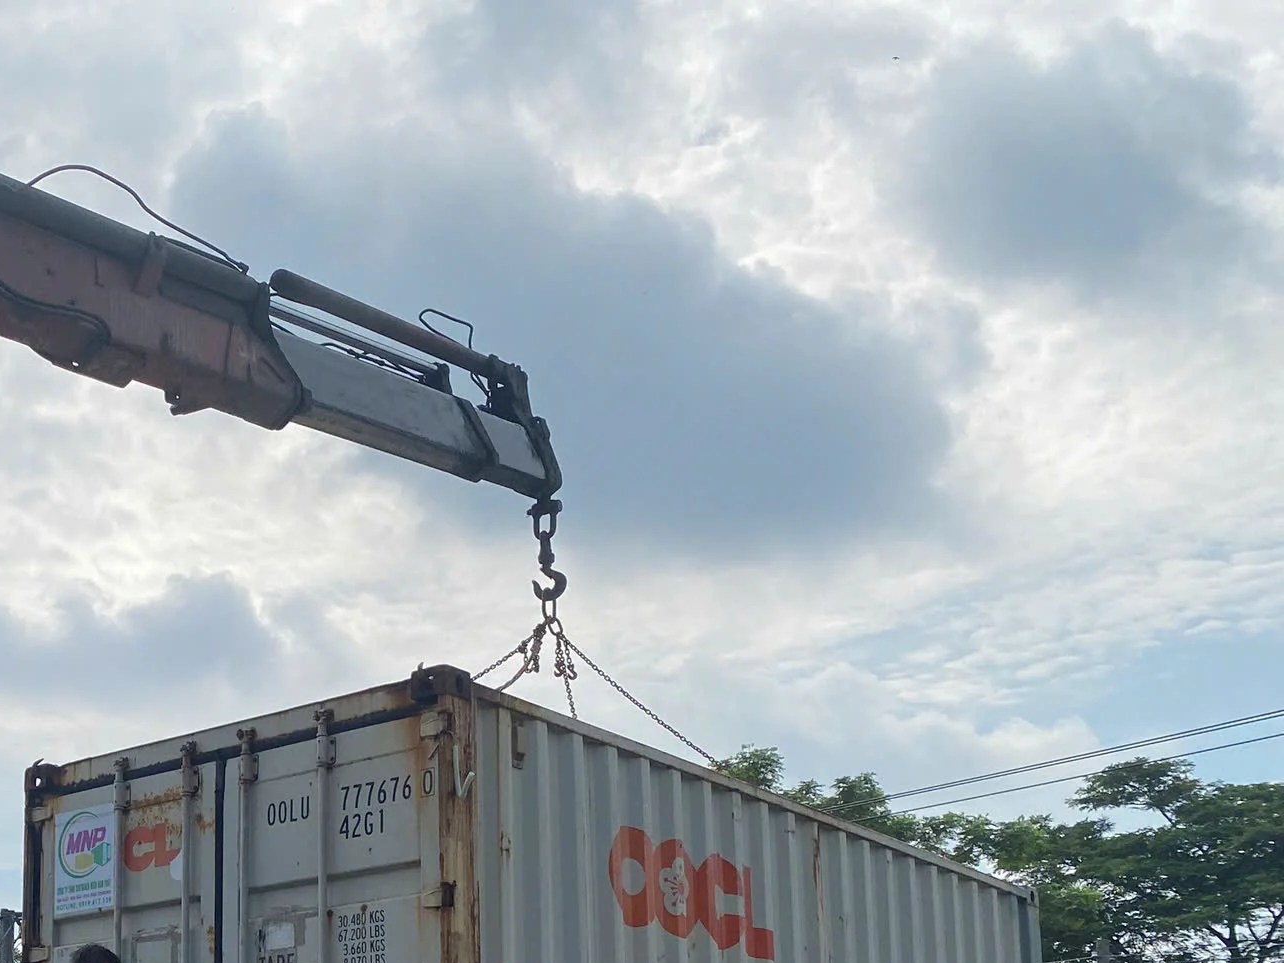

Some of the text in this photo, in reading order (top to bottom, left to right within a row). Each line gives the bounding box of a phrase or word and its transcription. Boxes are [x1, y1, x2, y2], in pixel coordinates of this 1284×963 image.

[340, 775, 412, 811] 777676
[339, 809, 384, 839] 42G1
[66, 826, 107, 855] MNP
[338, 910, 385, 928] 30.480 KGS
[338, 925, 386, 943] 67.200 LBS
[343, 939, 386, 956] 3.660 KGS
